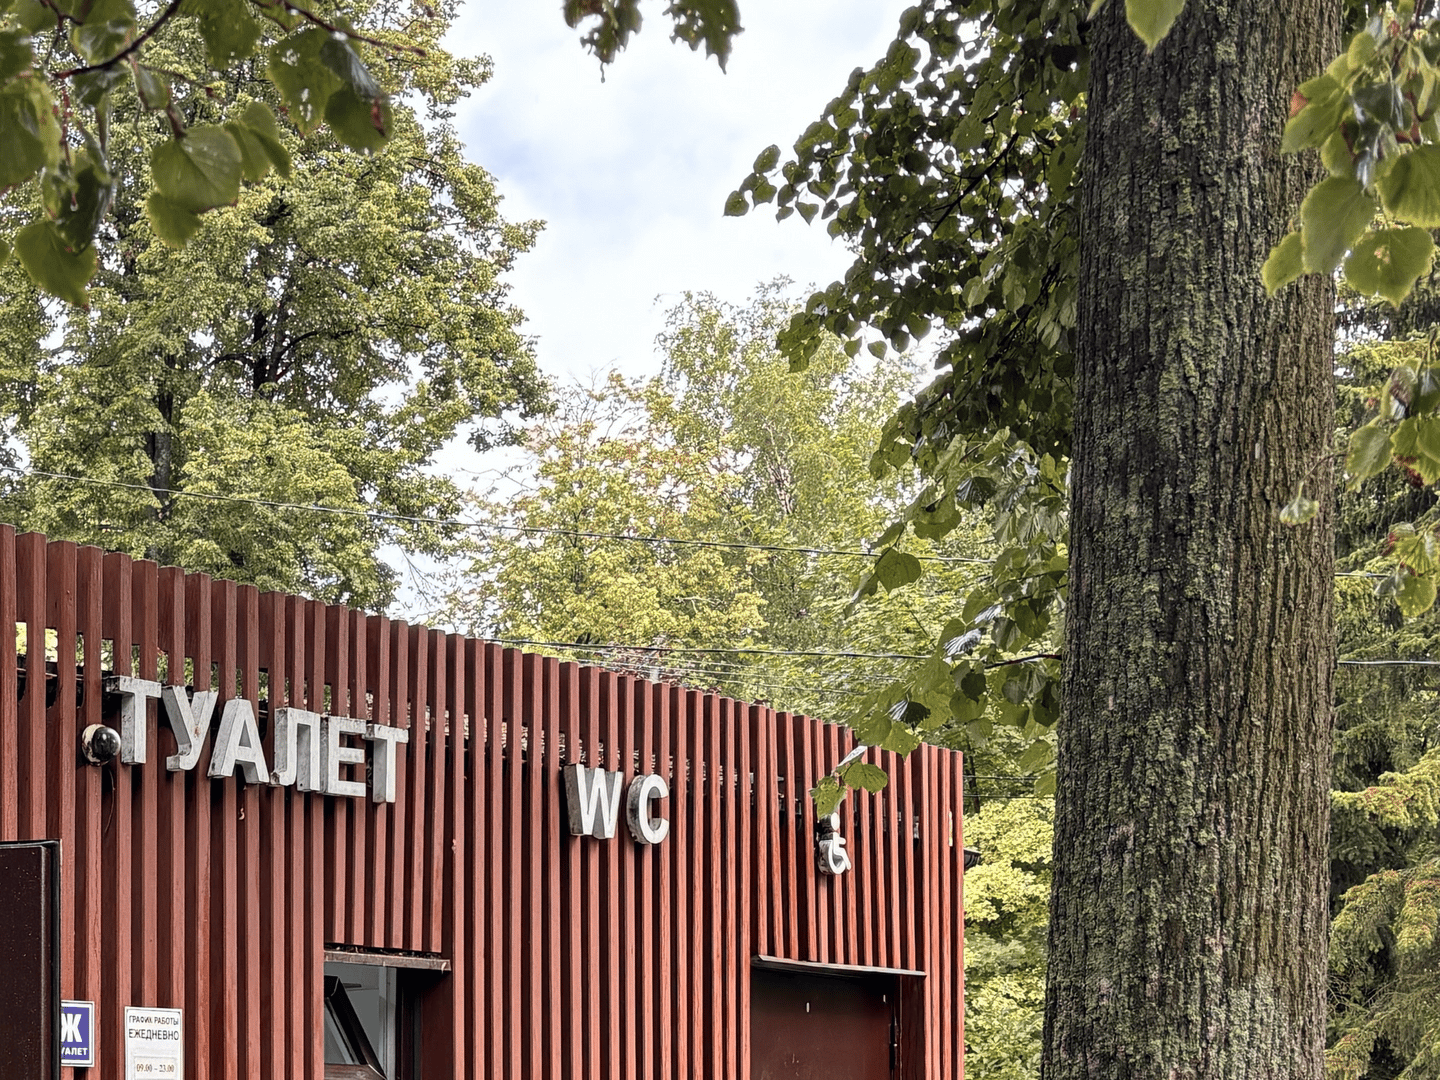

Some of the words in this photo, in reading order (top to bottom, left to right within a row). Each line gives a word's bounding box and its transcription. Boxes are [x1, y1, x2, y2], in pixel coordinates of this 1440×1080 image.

[106, 675, 409, 803] ТУАЛЕТ
[563, 763, 670, 844] WC
[61, 1013, 83, 1042] Ж
[128, 1015, 153, 1023] ГРАФИК
[154, 1016, 179, 1025] РАБОТЫ
[128, 1028, 180, 1041] ЕЖЕДНЕВНО
